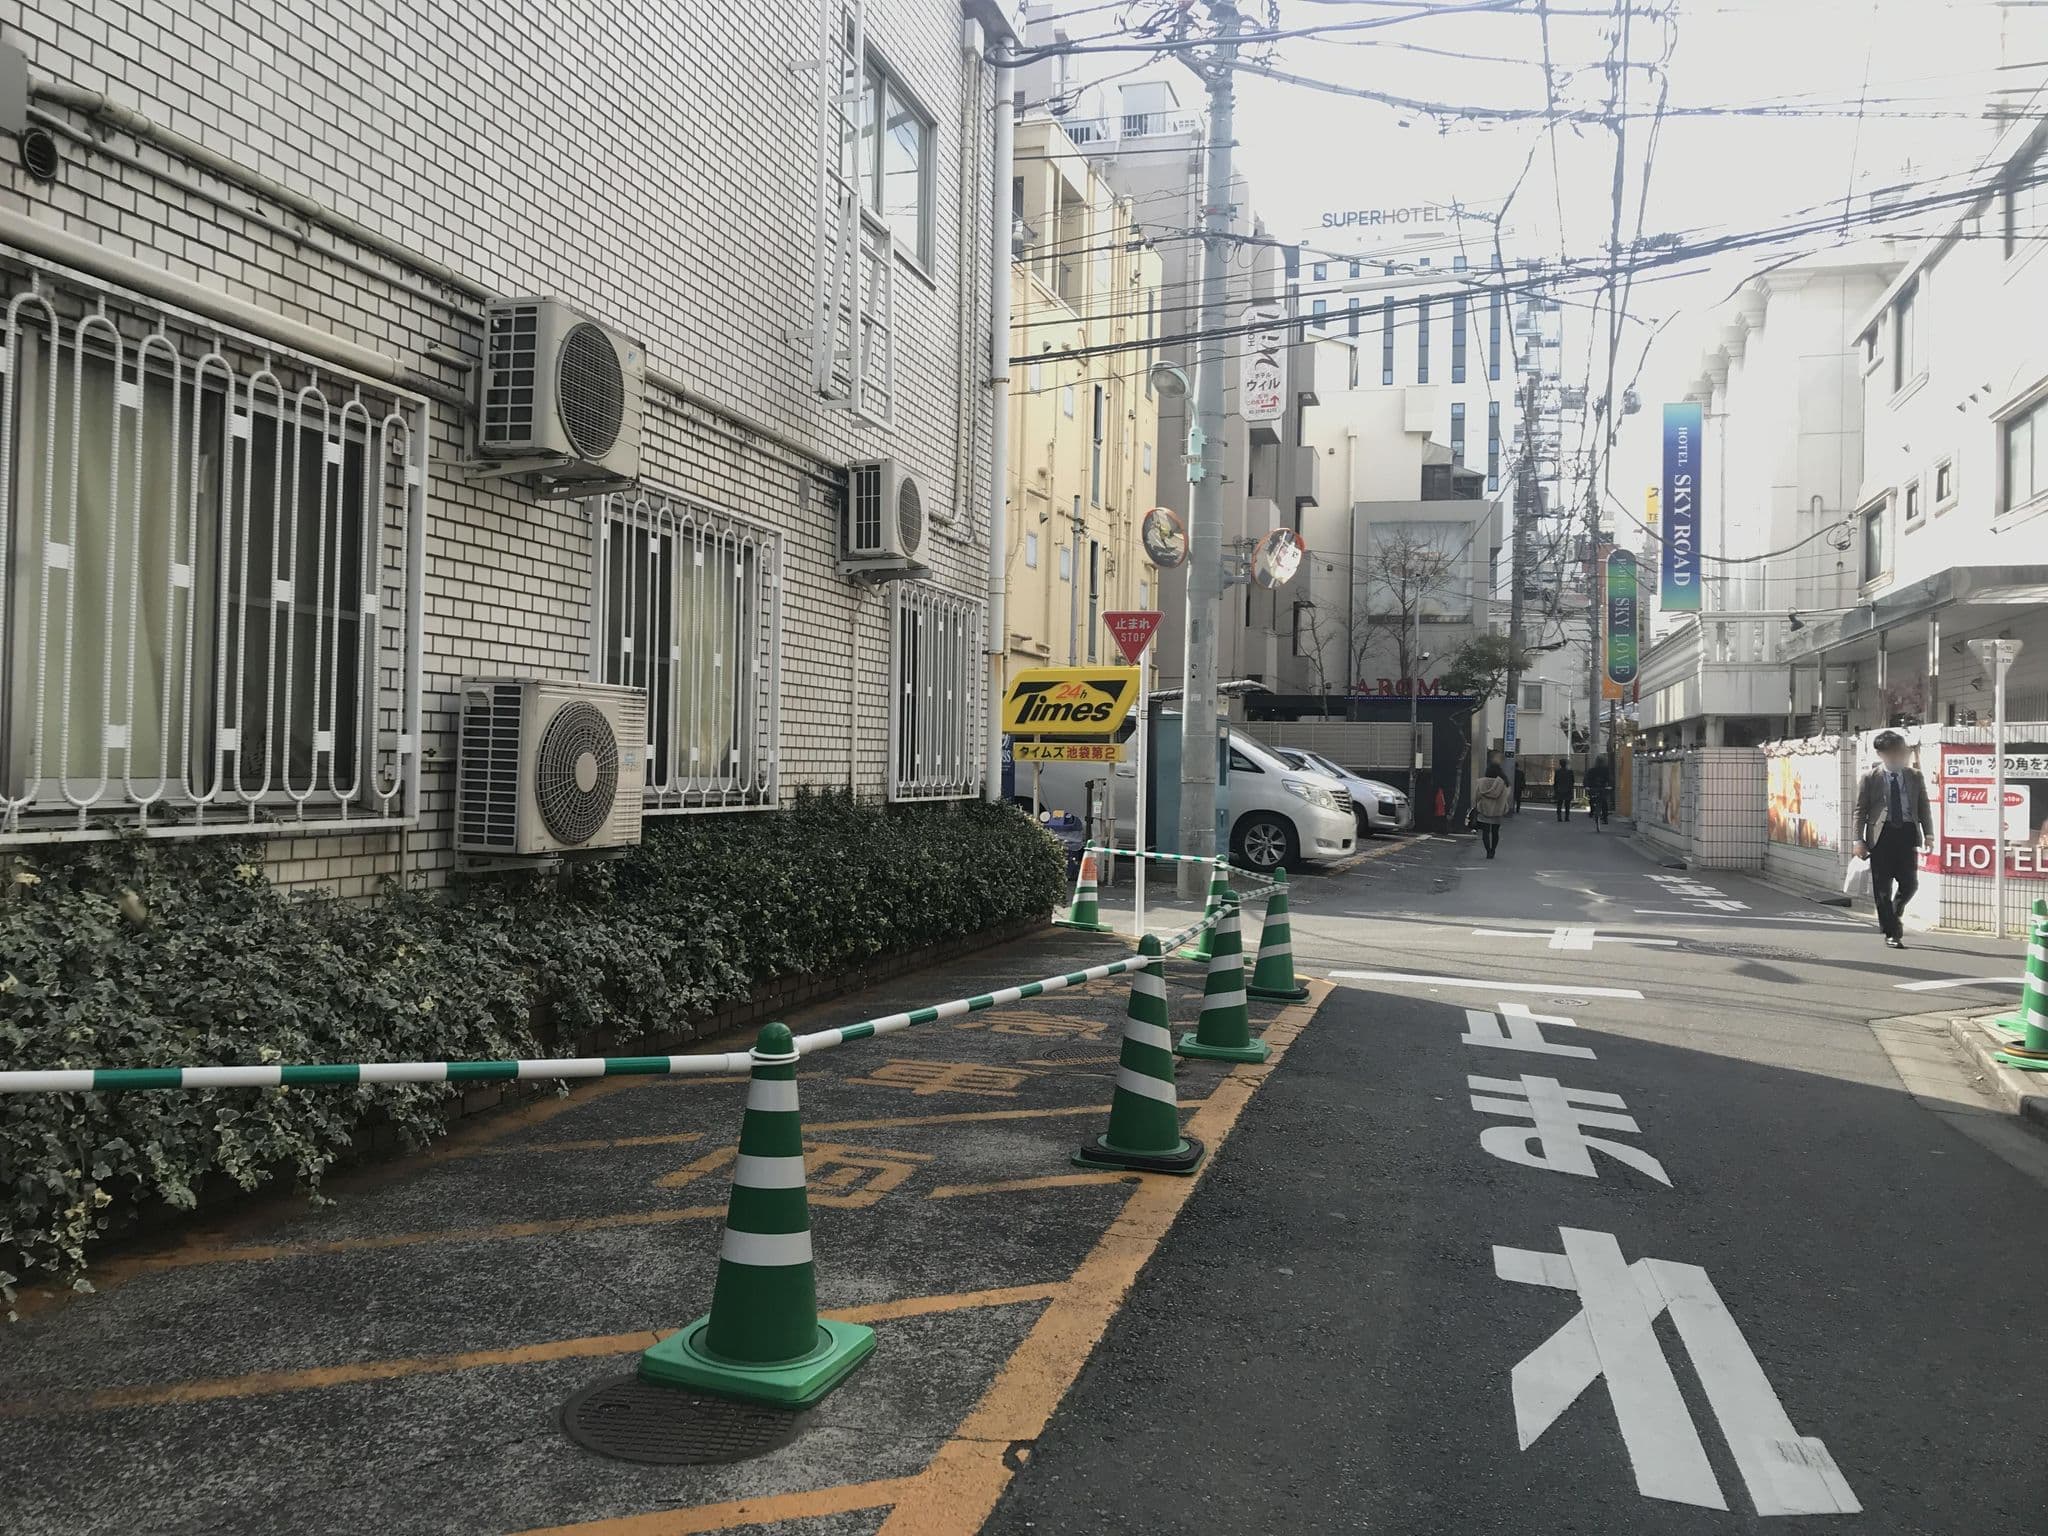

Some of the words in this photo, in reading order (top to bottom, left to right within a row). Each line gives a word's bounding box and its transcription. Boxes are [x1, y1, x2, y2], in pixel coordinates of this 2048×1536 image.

[1247, 377, 1281, 391] ウィル
[1678, 427, 1688, 467] HOTEL
[1674, 474, 1692, 518] SKY
[1674, 524, 1691, 587] ROAD
[1114, 617, 1151, 630] 止まれ
[1615, 597, 1630, 627] SKY
[1120, 632, 1146, 642] STOP
[1615, 633, 1630, 675] LOVE
[1013, 693, 1114, 725] Times
[1460, 1002, 1863, 1518] 止まれ
